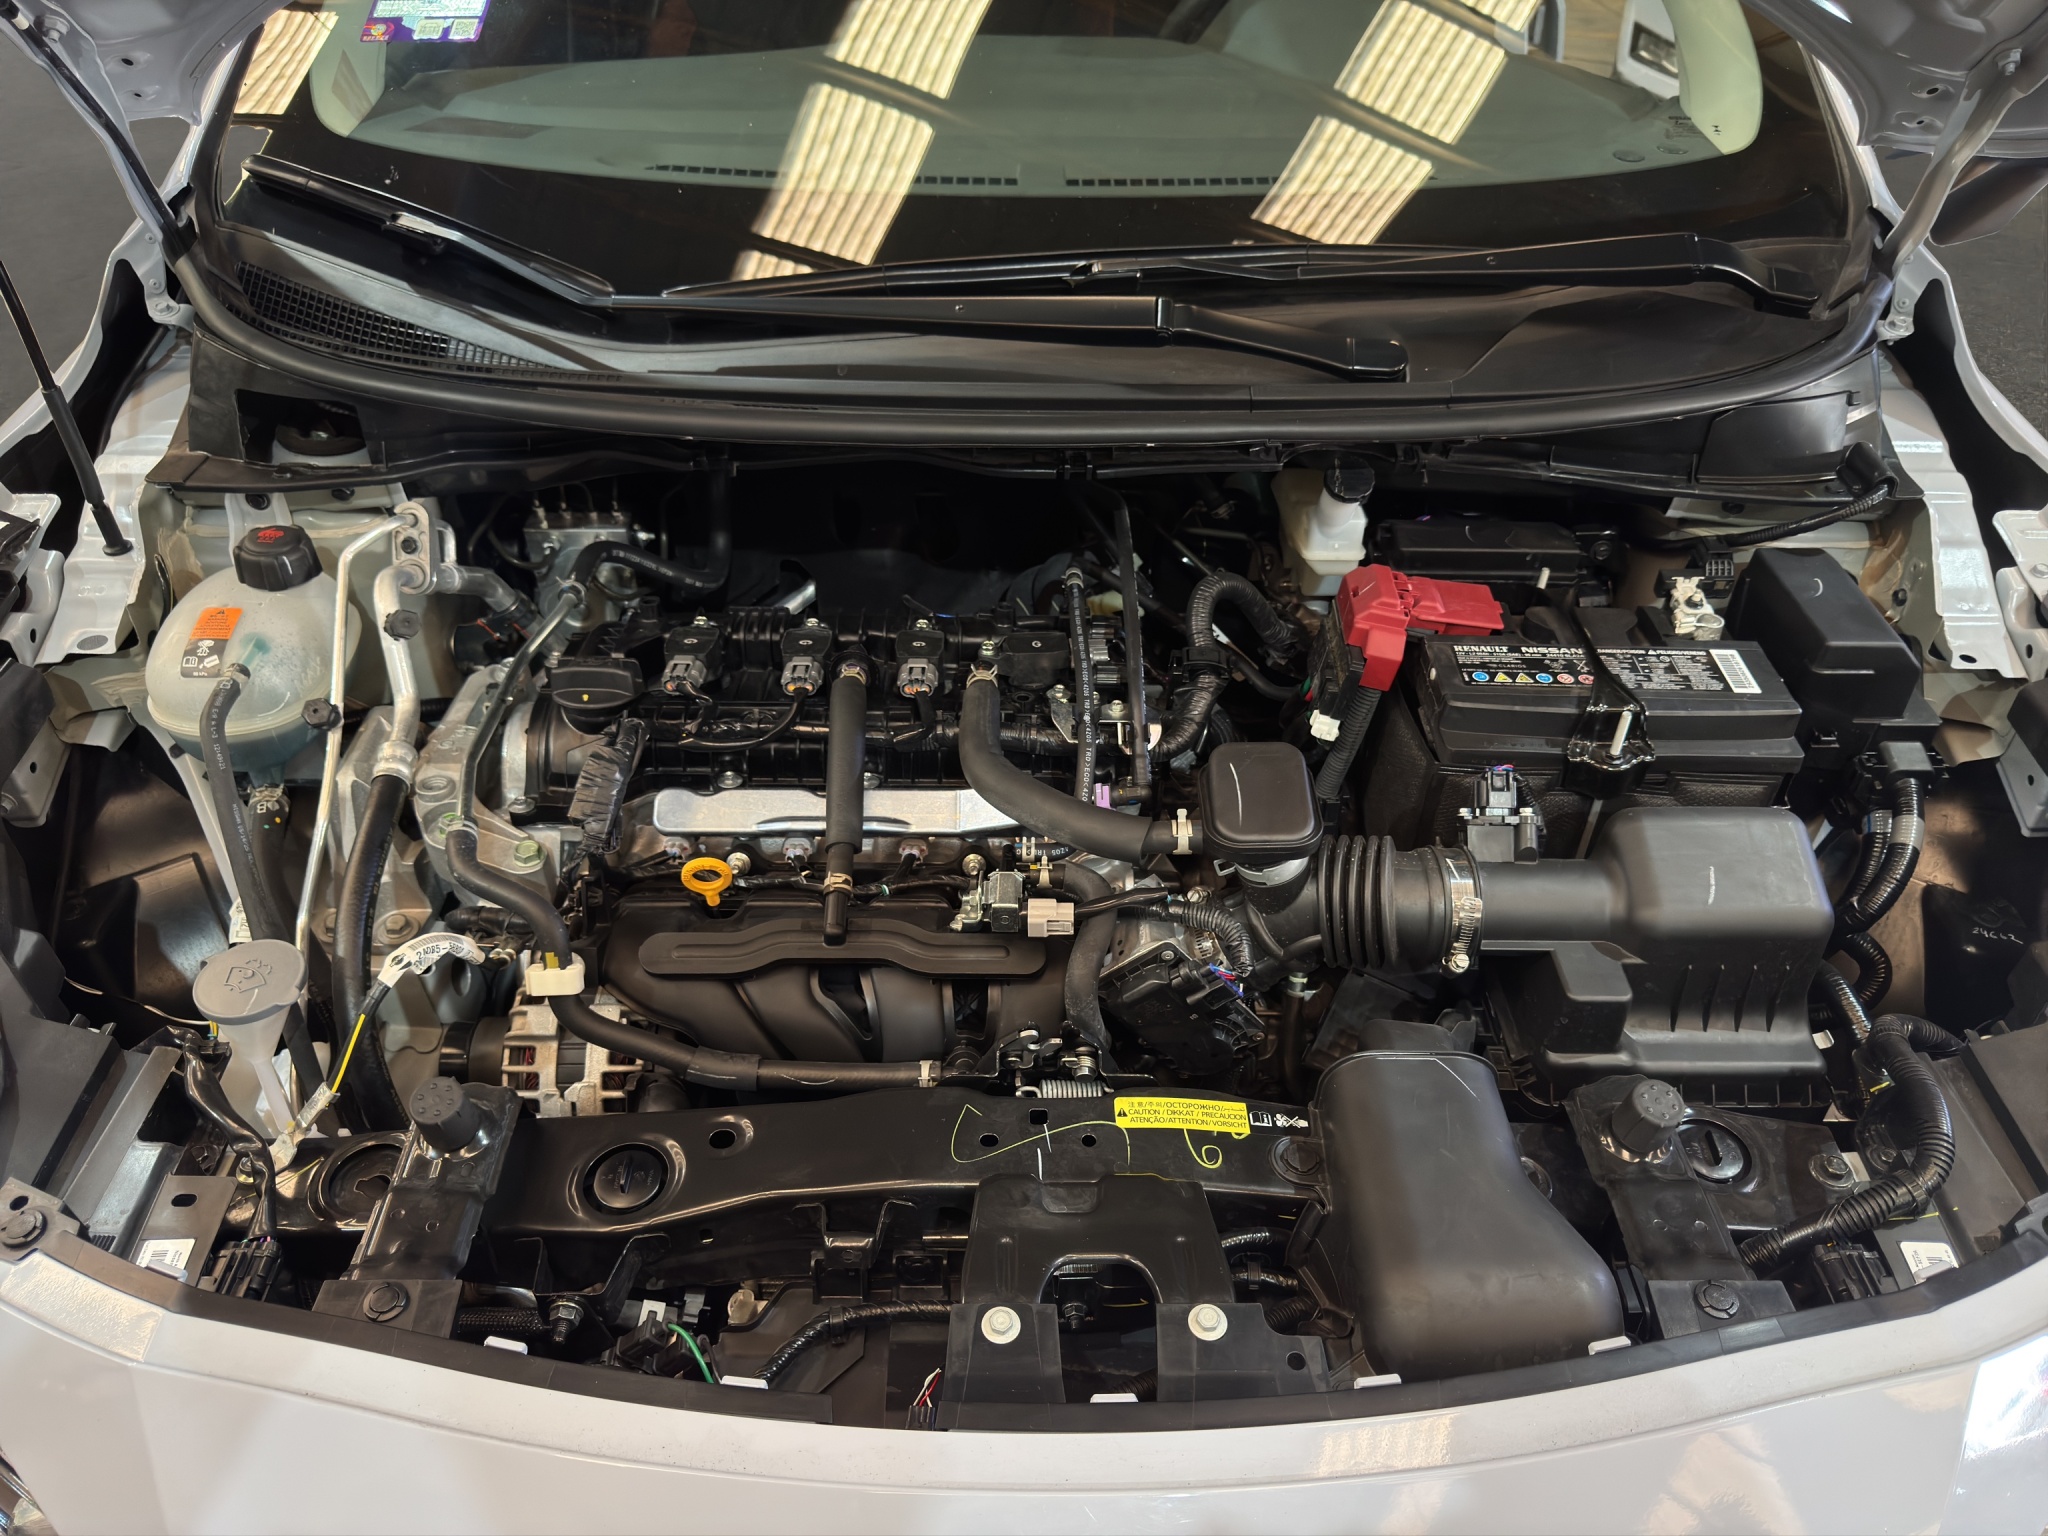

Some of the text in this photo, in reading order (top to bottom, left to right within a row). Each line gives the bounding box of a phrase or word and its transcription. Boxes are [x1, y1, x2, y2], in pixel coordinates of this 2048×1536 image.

[1453, 645, 1583, 655] RENAULT NISSAN
[1128, 1108, 1160, 1116] CAUTION
[1166, 1109, 1195, 1117] DIKKAT
